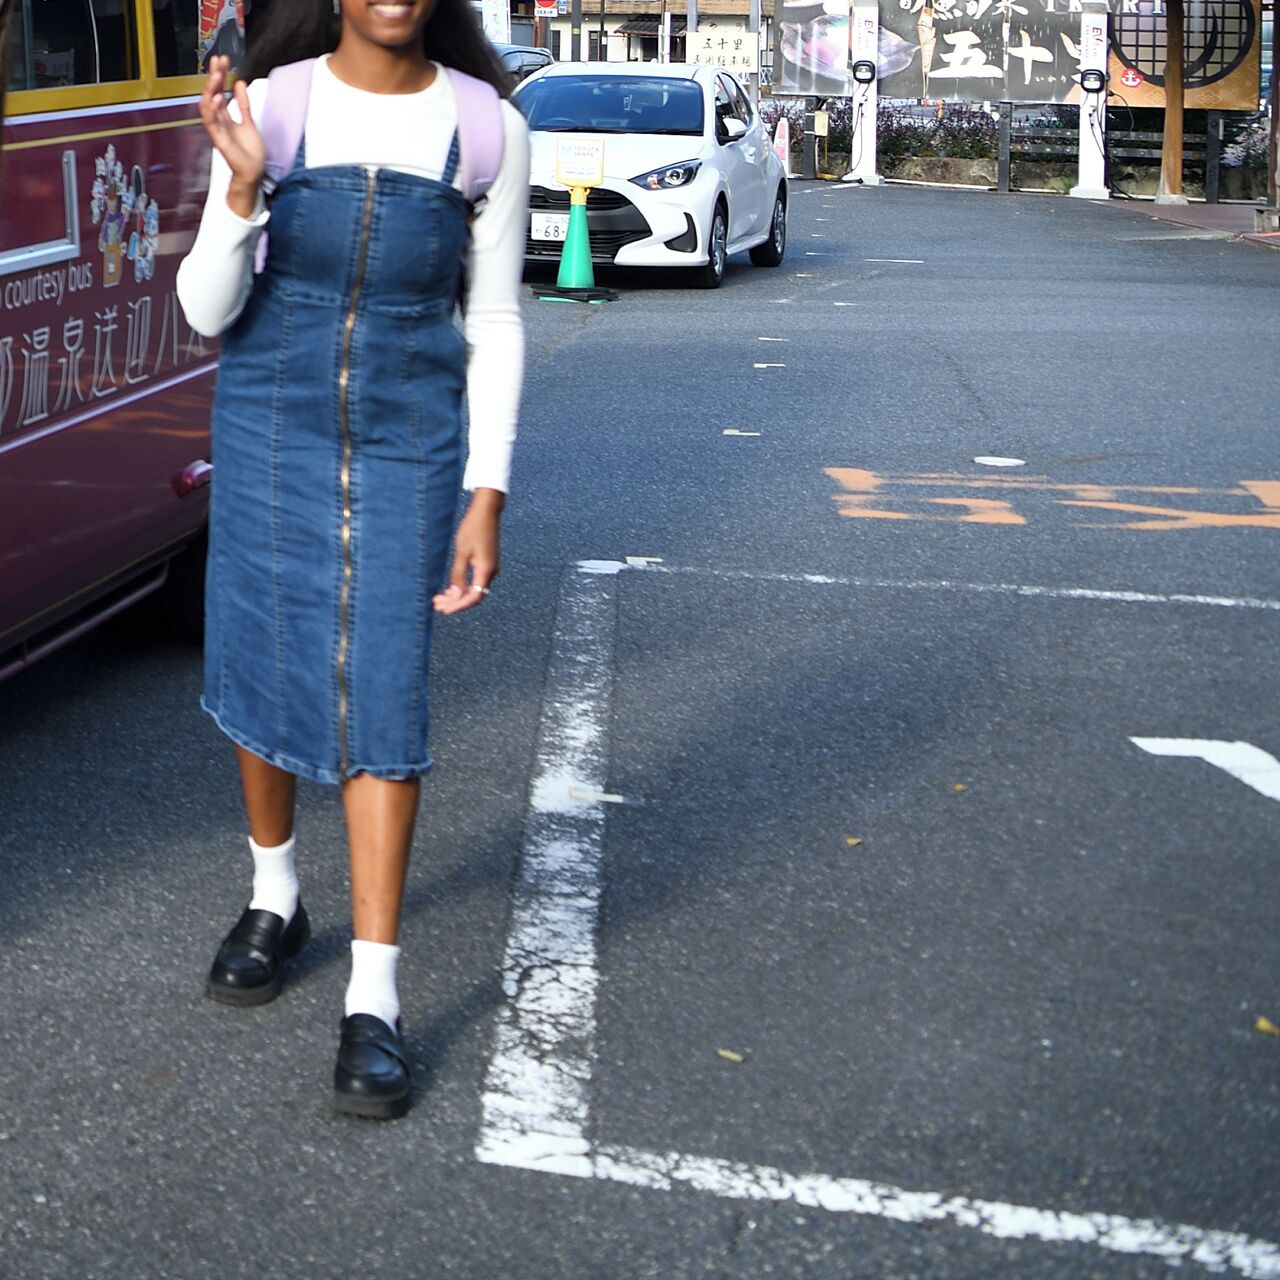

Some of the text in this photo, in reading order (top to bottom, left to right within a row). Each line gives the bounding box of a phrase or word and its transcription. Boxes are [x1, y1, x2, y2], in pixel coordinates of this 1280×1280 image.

[703, 38, 743, 51] 五十里
[4, 268, 67, 310] courtesy
[68, 260, 93, 293] bus
